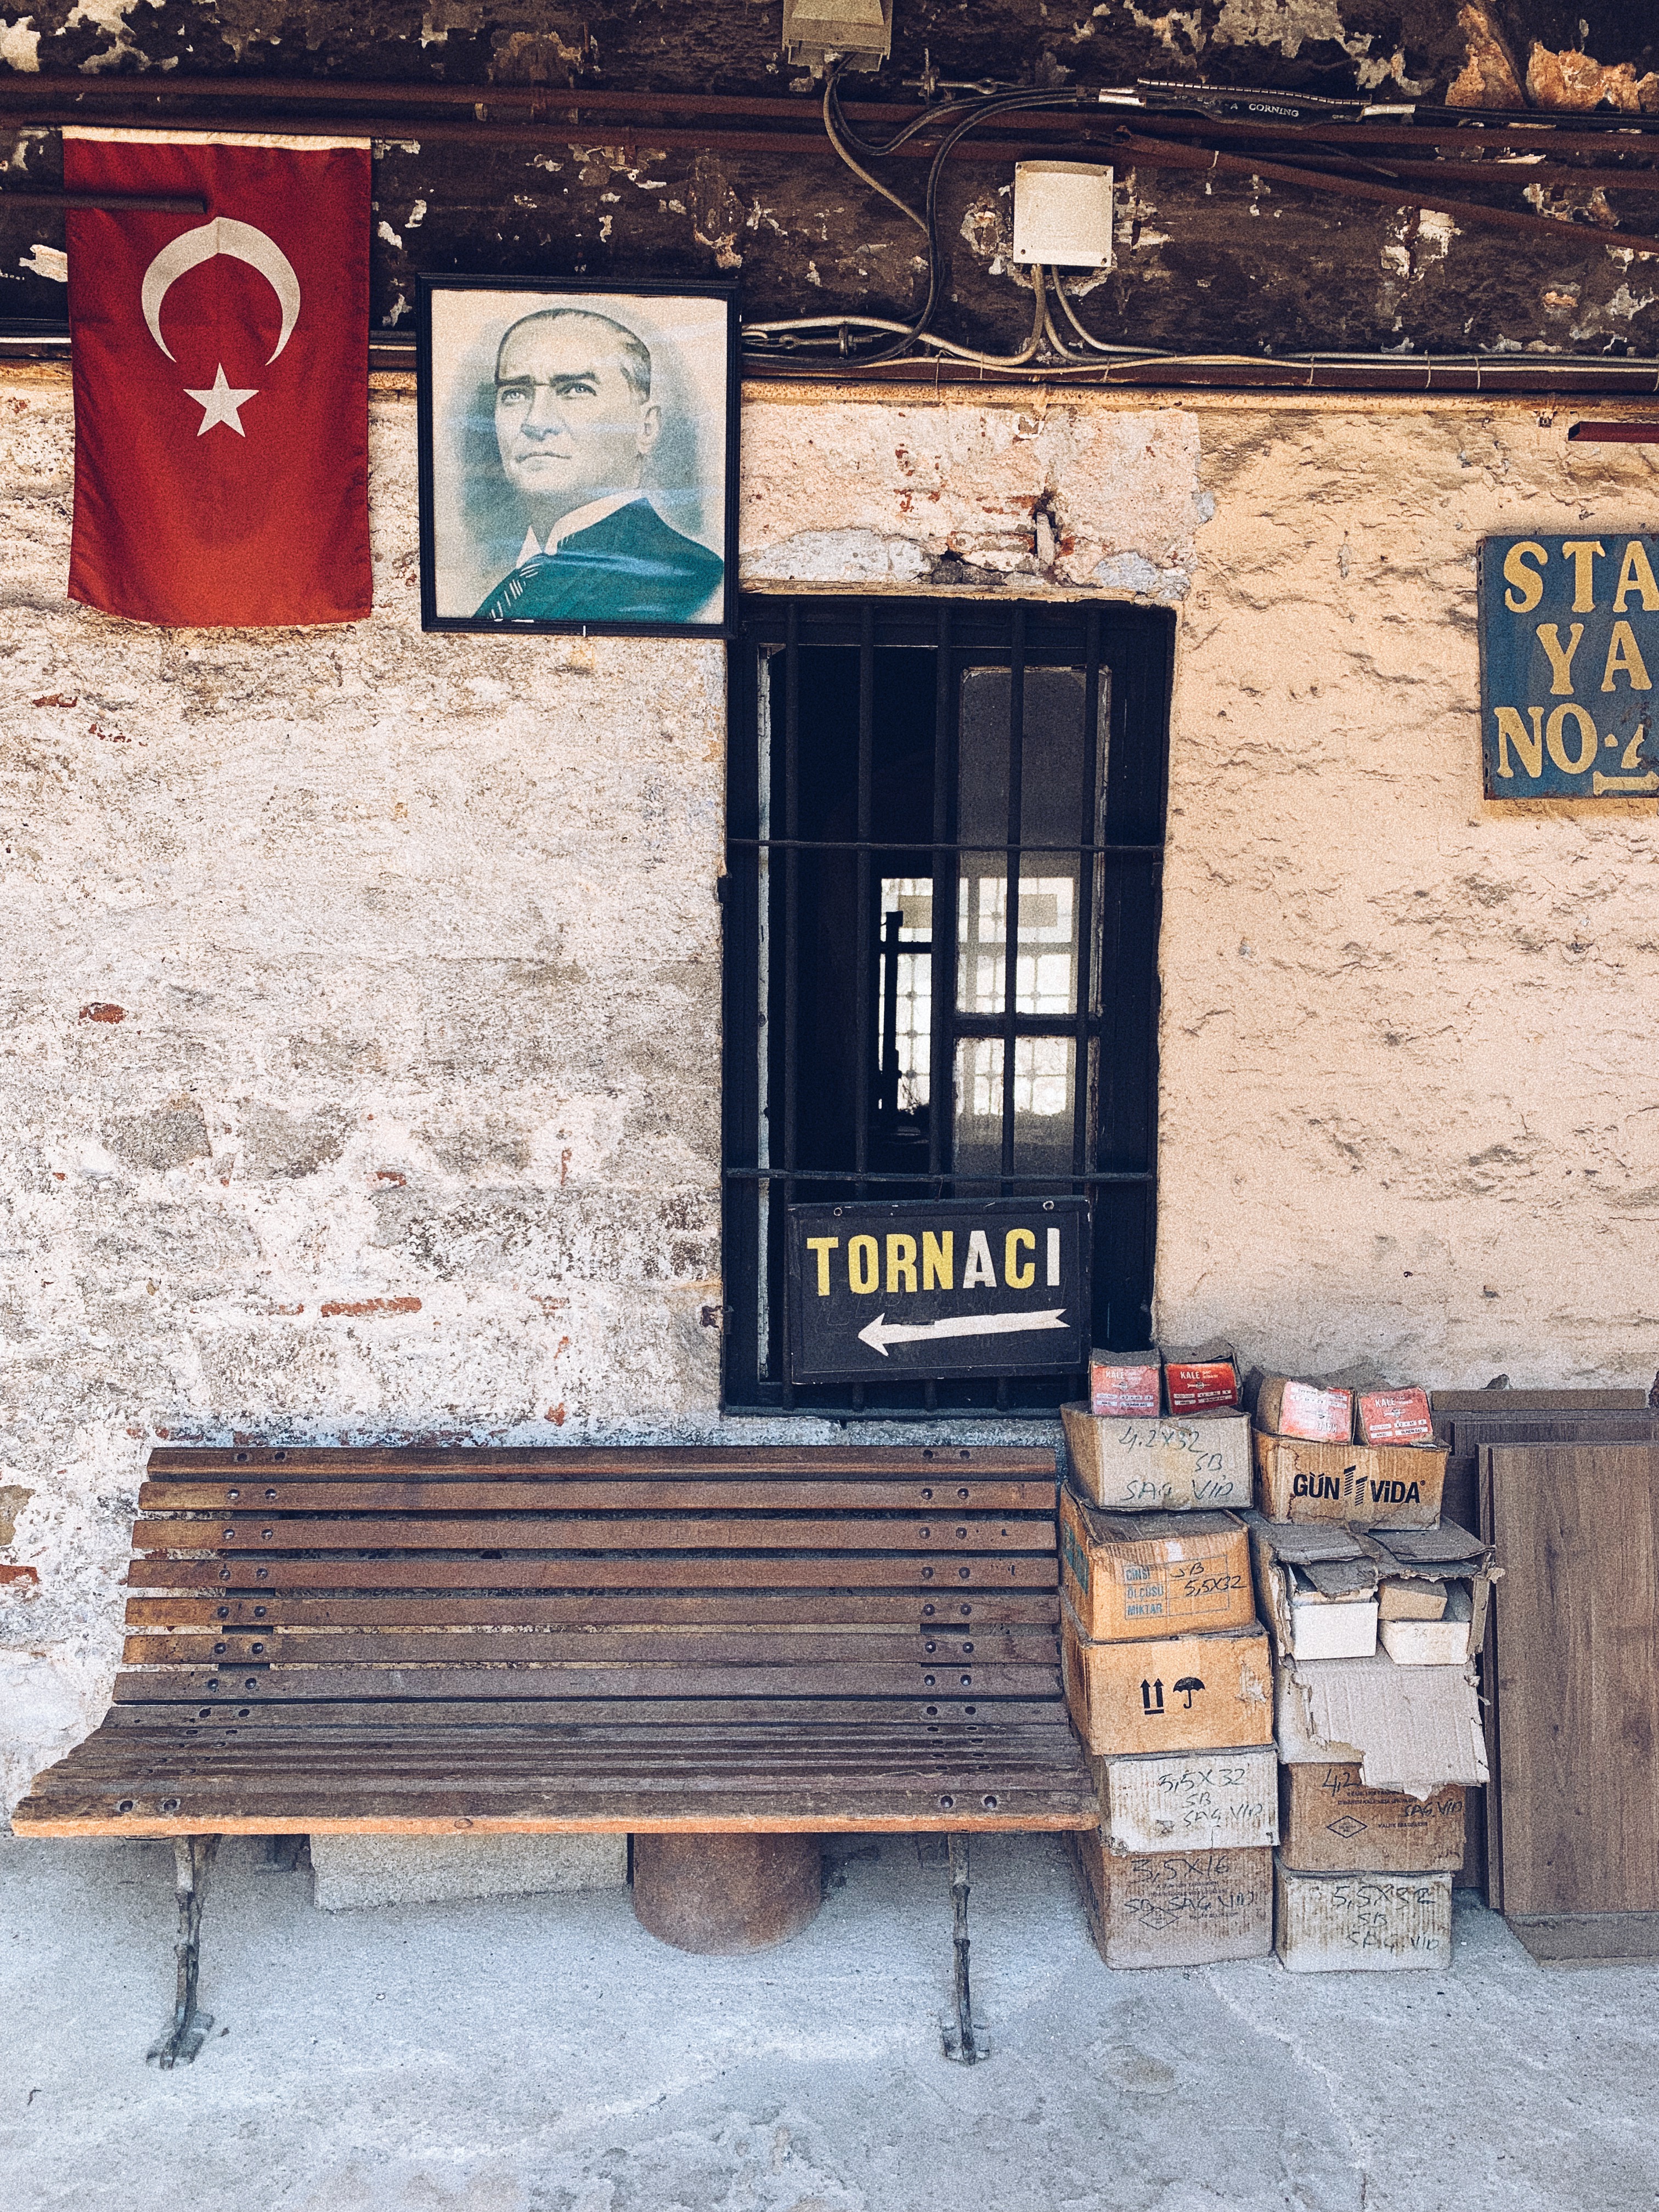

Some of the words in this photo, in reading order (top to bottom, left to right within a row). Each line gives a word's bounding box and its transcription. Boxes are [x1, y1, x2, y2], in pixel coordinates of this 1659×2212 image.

[1249, 103, 1299, 117] CORNING
[807, 1228, 1060, 1296] TORNACI
[1105, 1370, 1125, 1379] KALE
[1375, 1398, 1396, 1408] KALE
[1317, 1421, 1338, 1433] KALE
[1293, 1471, 1340, 1500] GÜN
